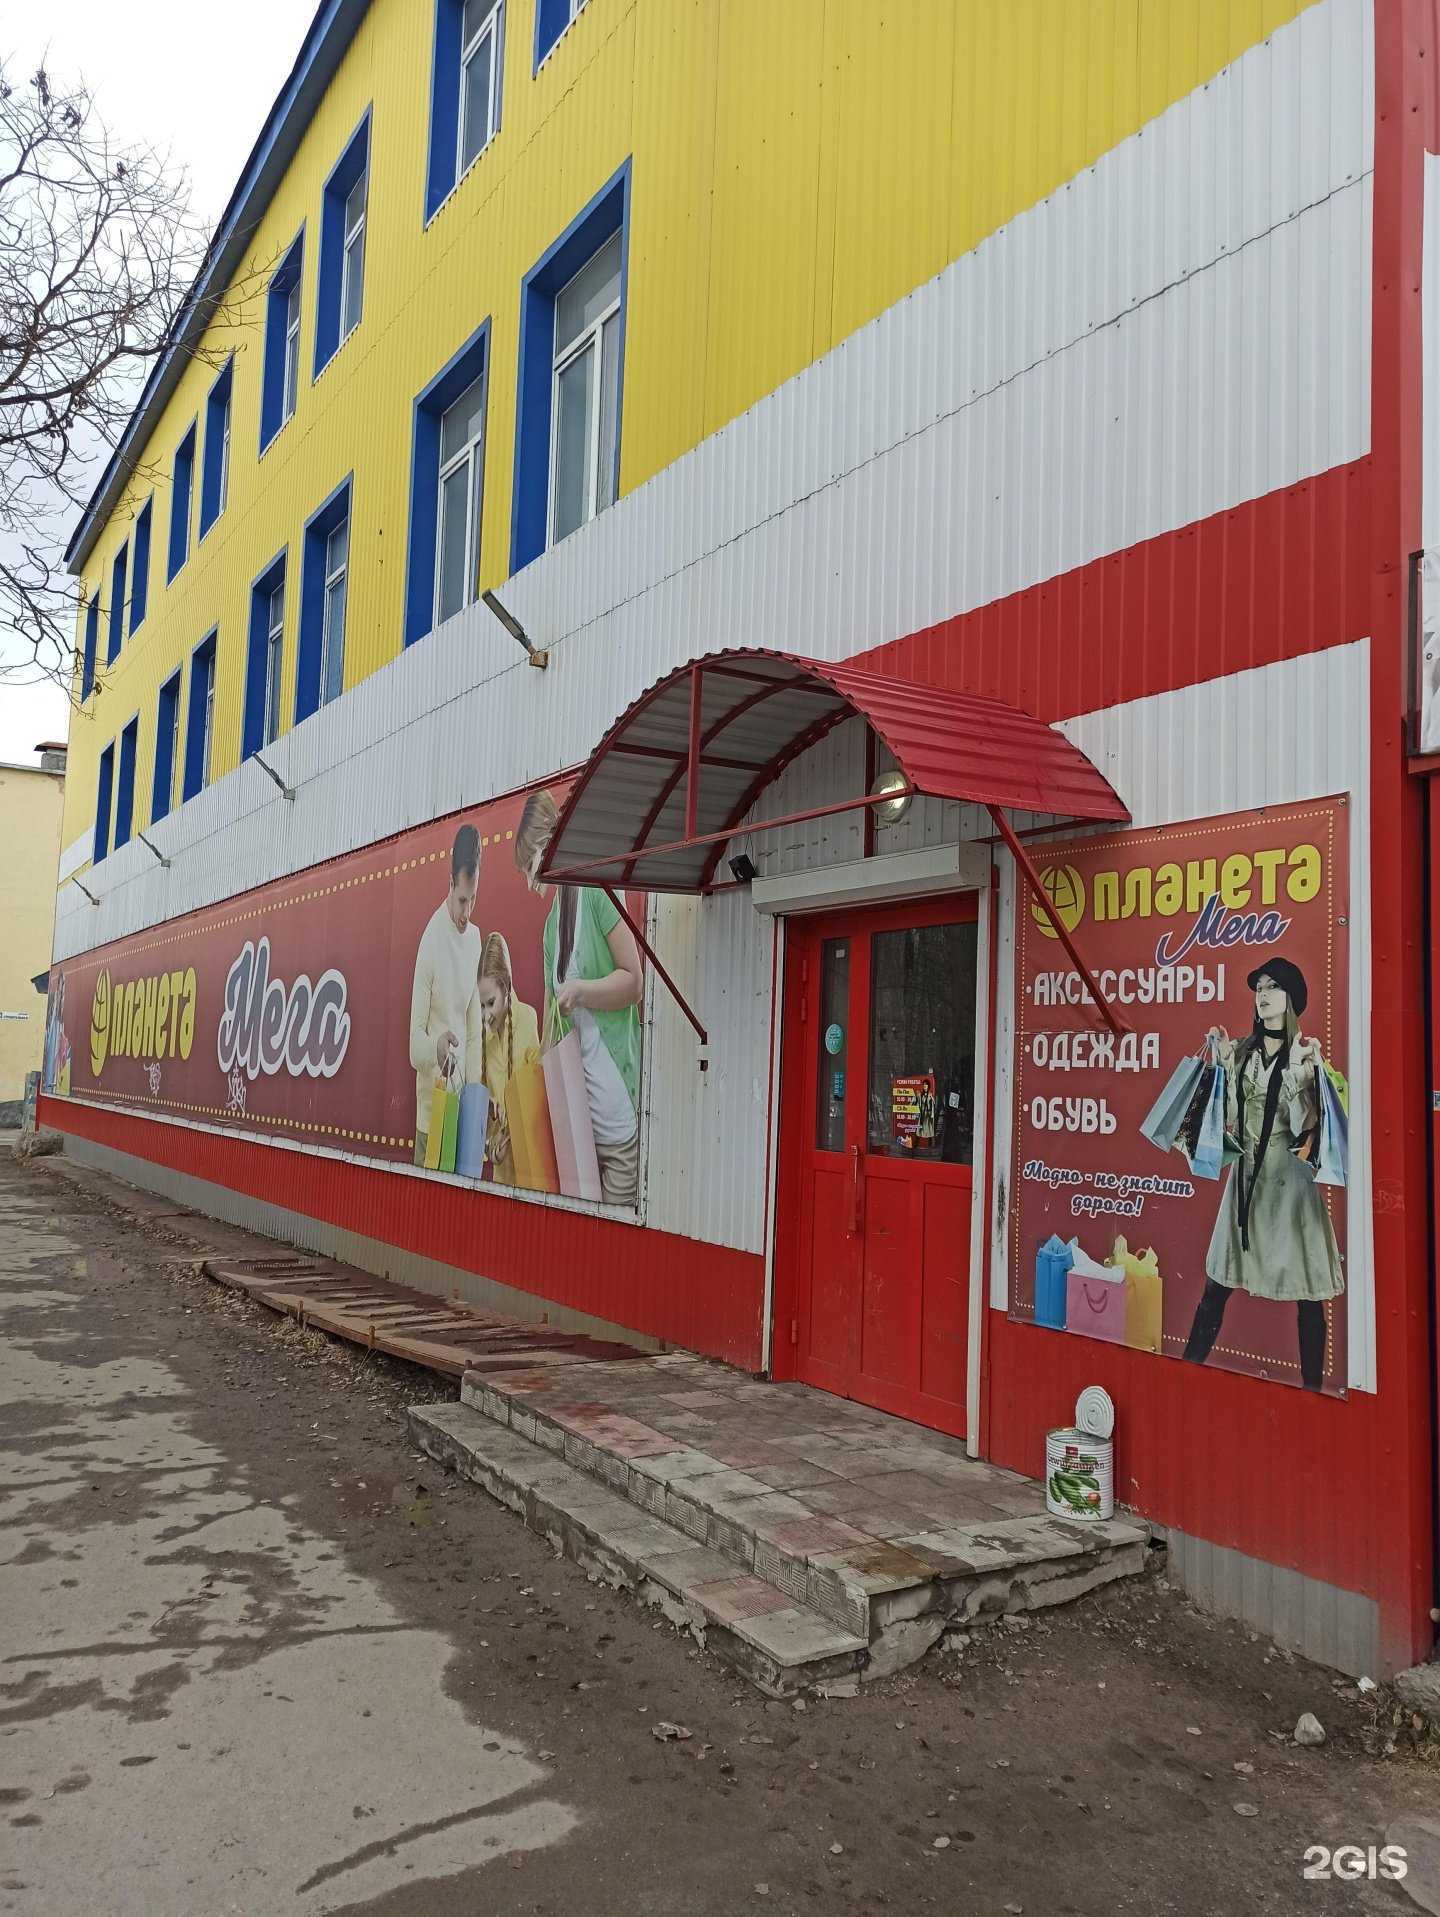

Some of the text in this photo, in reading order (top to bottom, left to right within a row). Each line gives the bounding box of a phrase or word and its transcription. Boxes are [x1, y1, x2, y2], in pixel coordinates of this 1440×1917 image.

[1155, 890, 1292, 968] Мега
[218, 935, 350, 1080] Мега
[1032, 1031, 1160, 1073] ОДЕЖДА
[1031, 1096, 1117, 1135] ОБУВЬ
[1023, 1160, 1083, 1188] Модно
[1094, 1172, 1118, 1188] не
[1118, 1175, 1194, 1197] значит
[1071, 1194, 1144, 1218] дорого!
